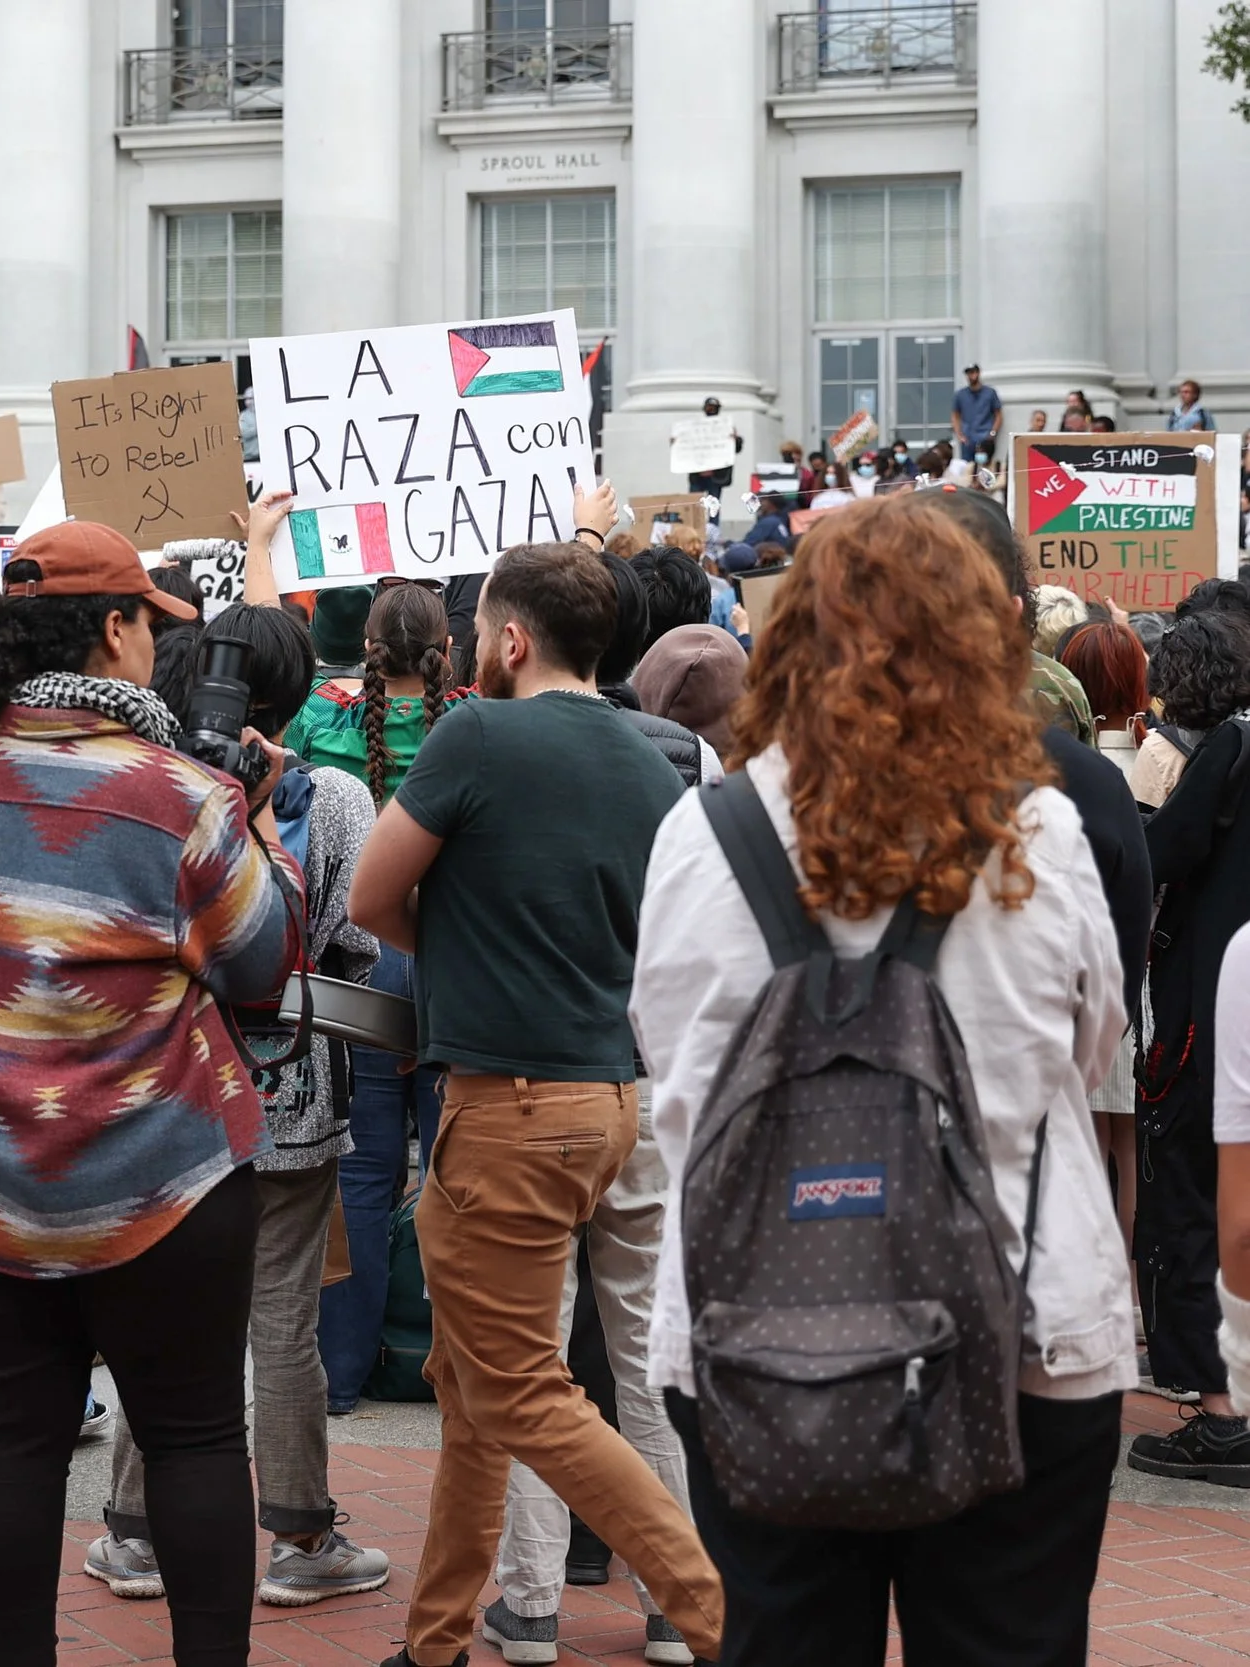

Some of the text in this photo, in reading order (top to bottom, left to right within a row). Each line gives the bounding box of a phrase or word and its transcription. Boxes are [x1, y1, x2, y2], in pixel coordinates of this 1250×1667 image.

[480, 153, 601, 171] SPROUL HALL
[279, 339, 393, 404] LA
[130, 390, 209, 438] Right
[71, 451, 110, 478] to
[284, 407, 584, 496] RAZA con
[1091, 448, 1159, 468] STAND
[1034, 474, 1066, 499] WE
[1098, 478, 1177, 499] WITH
[1079, 505, 1193, 531] PALESTINE
[1039, 539, 1179, 569] END THE
